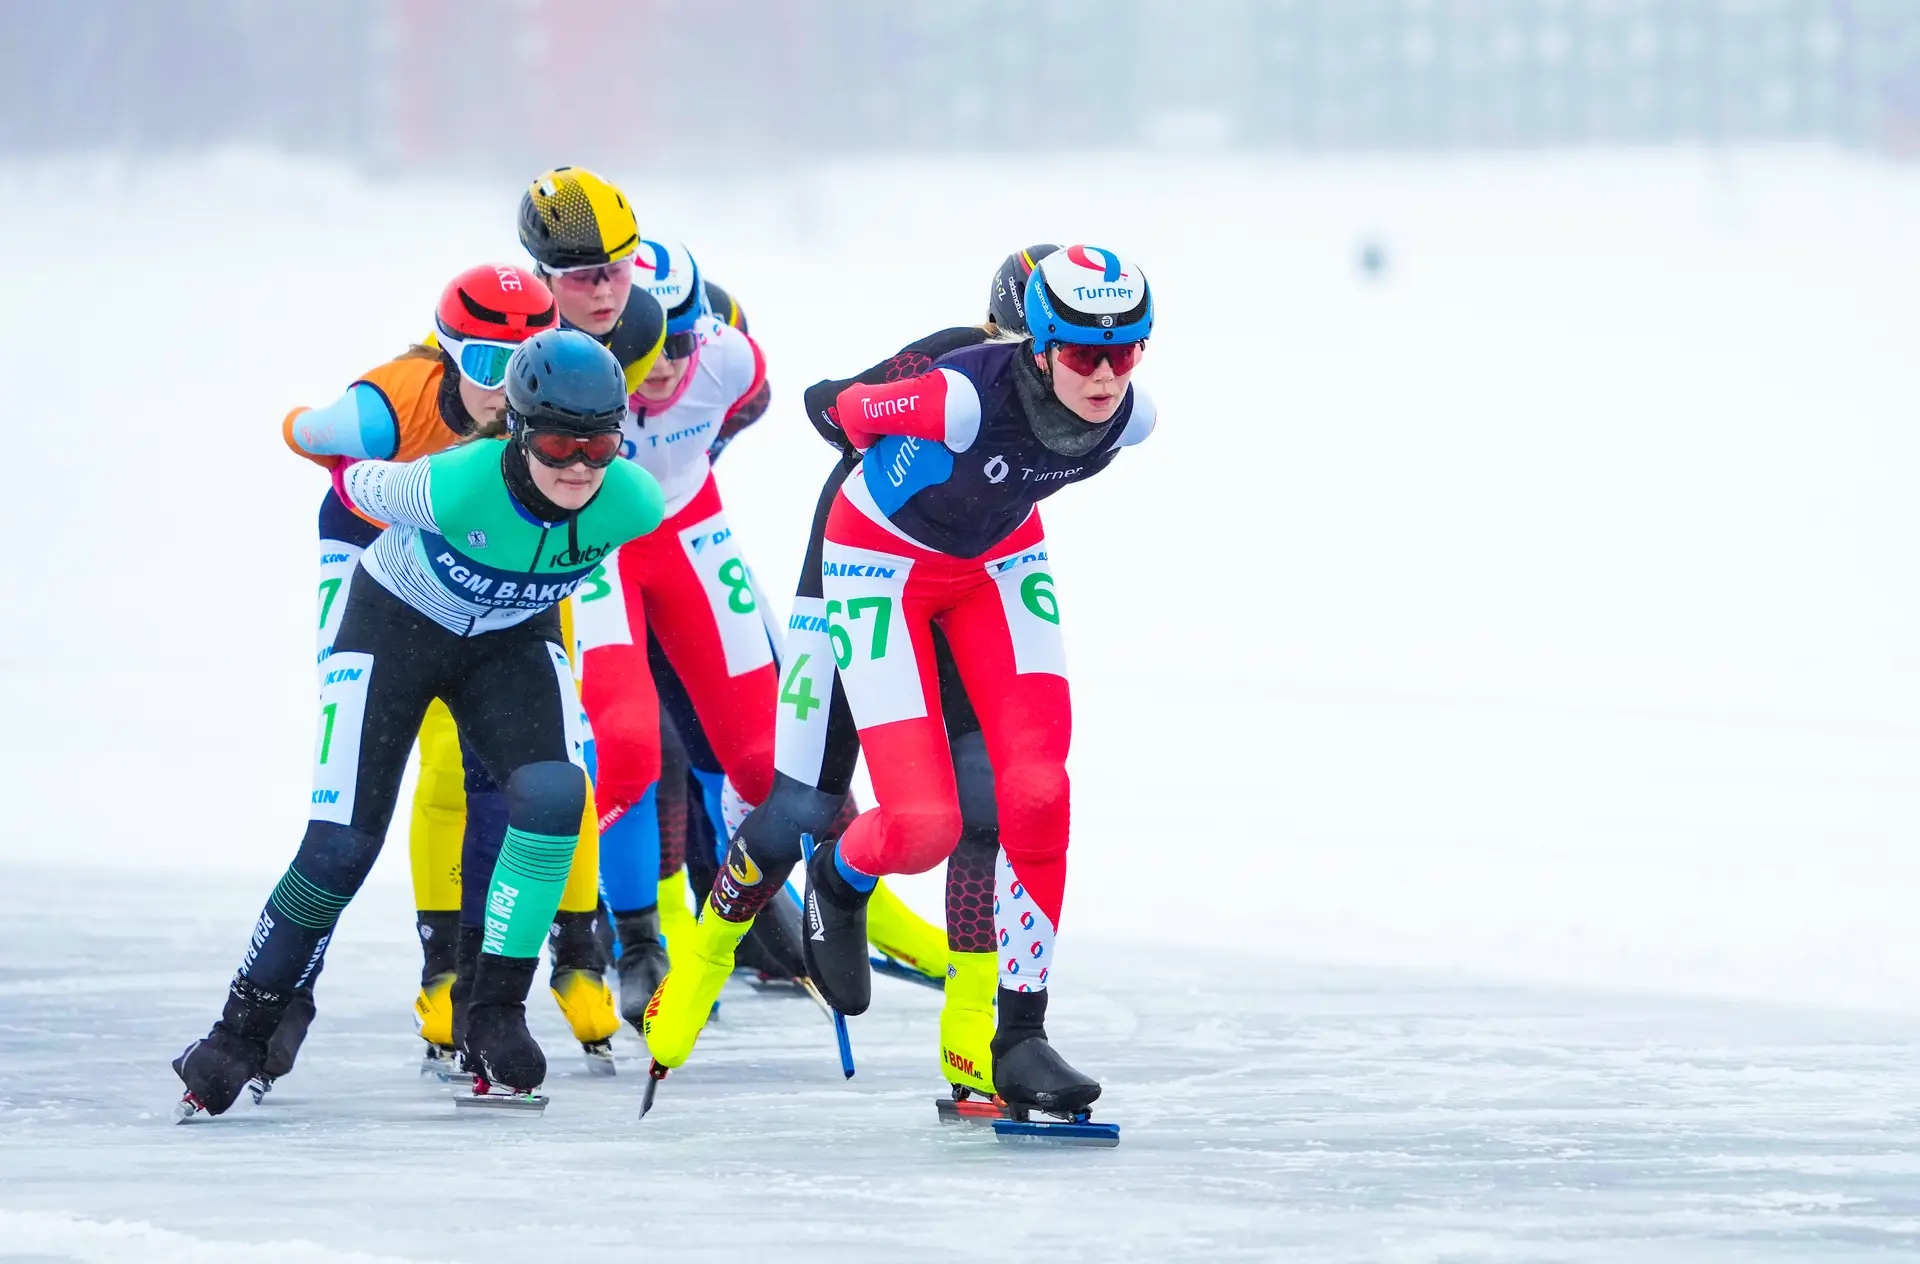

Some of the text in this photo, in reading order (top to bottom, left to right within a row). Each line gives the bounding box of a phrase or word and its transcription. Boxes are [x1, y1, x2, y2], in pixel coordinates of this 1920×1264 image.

[1073, 286, 1133, 301] Turner
[861, 395, 920, 420] Turner
[436, 552, 493, 595] PGM
[718, 557, 757, 615] 8
[823, 561, 896, 579] DAIKIN
[318, 577, 343, 630] 7
[474, 595, 514, 607] VAST
[1020, 572, 1060, 626] 6
[825, 596, 892, 671] 67
[780, 653, 821, 721] 4
[319, 702, 338, 765] 1
[488, 881, 520, 920] PGM
[808, 892, 818, 930] VIKING
